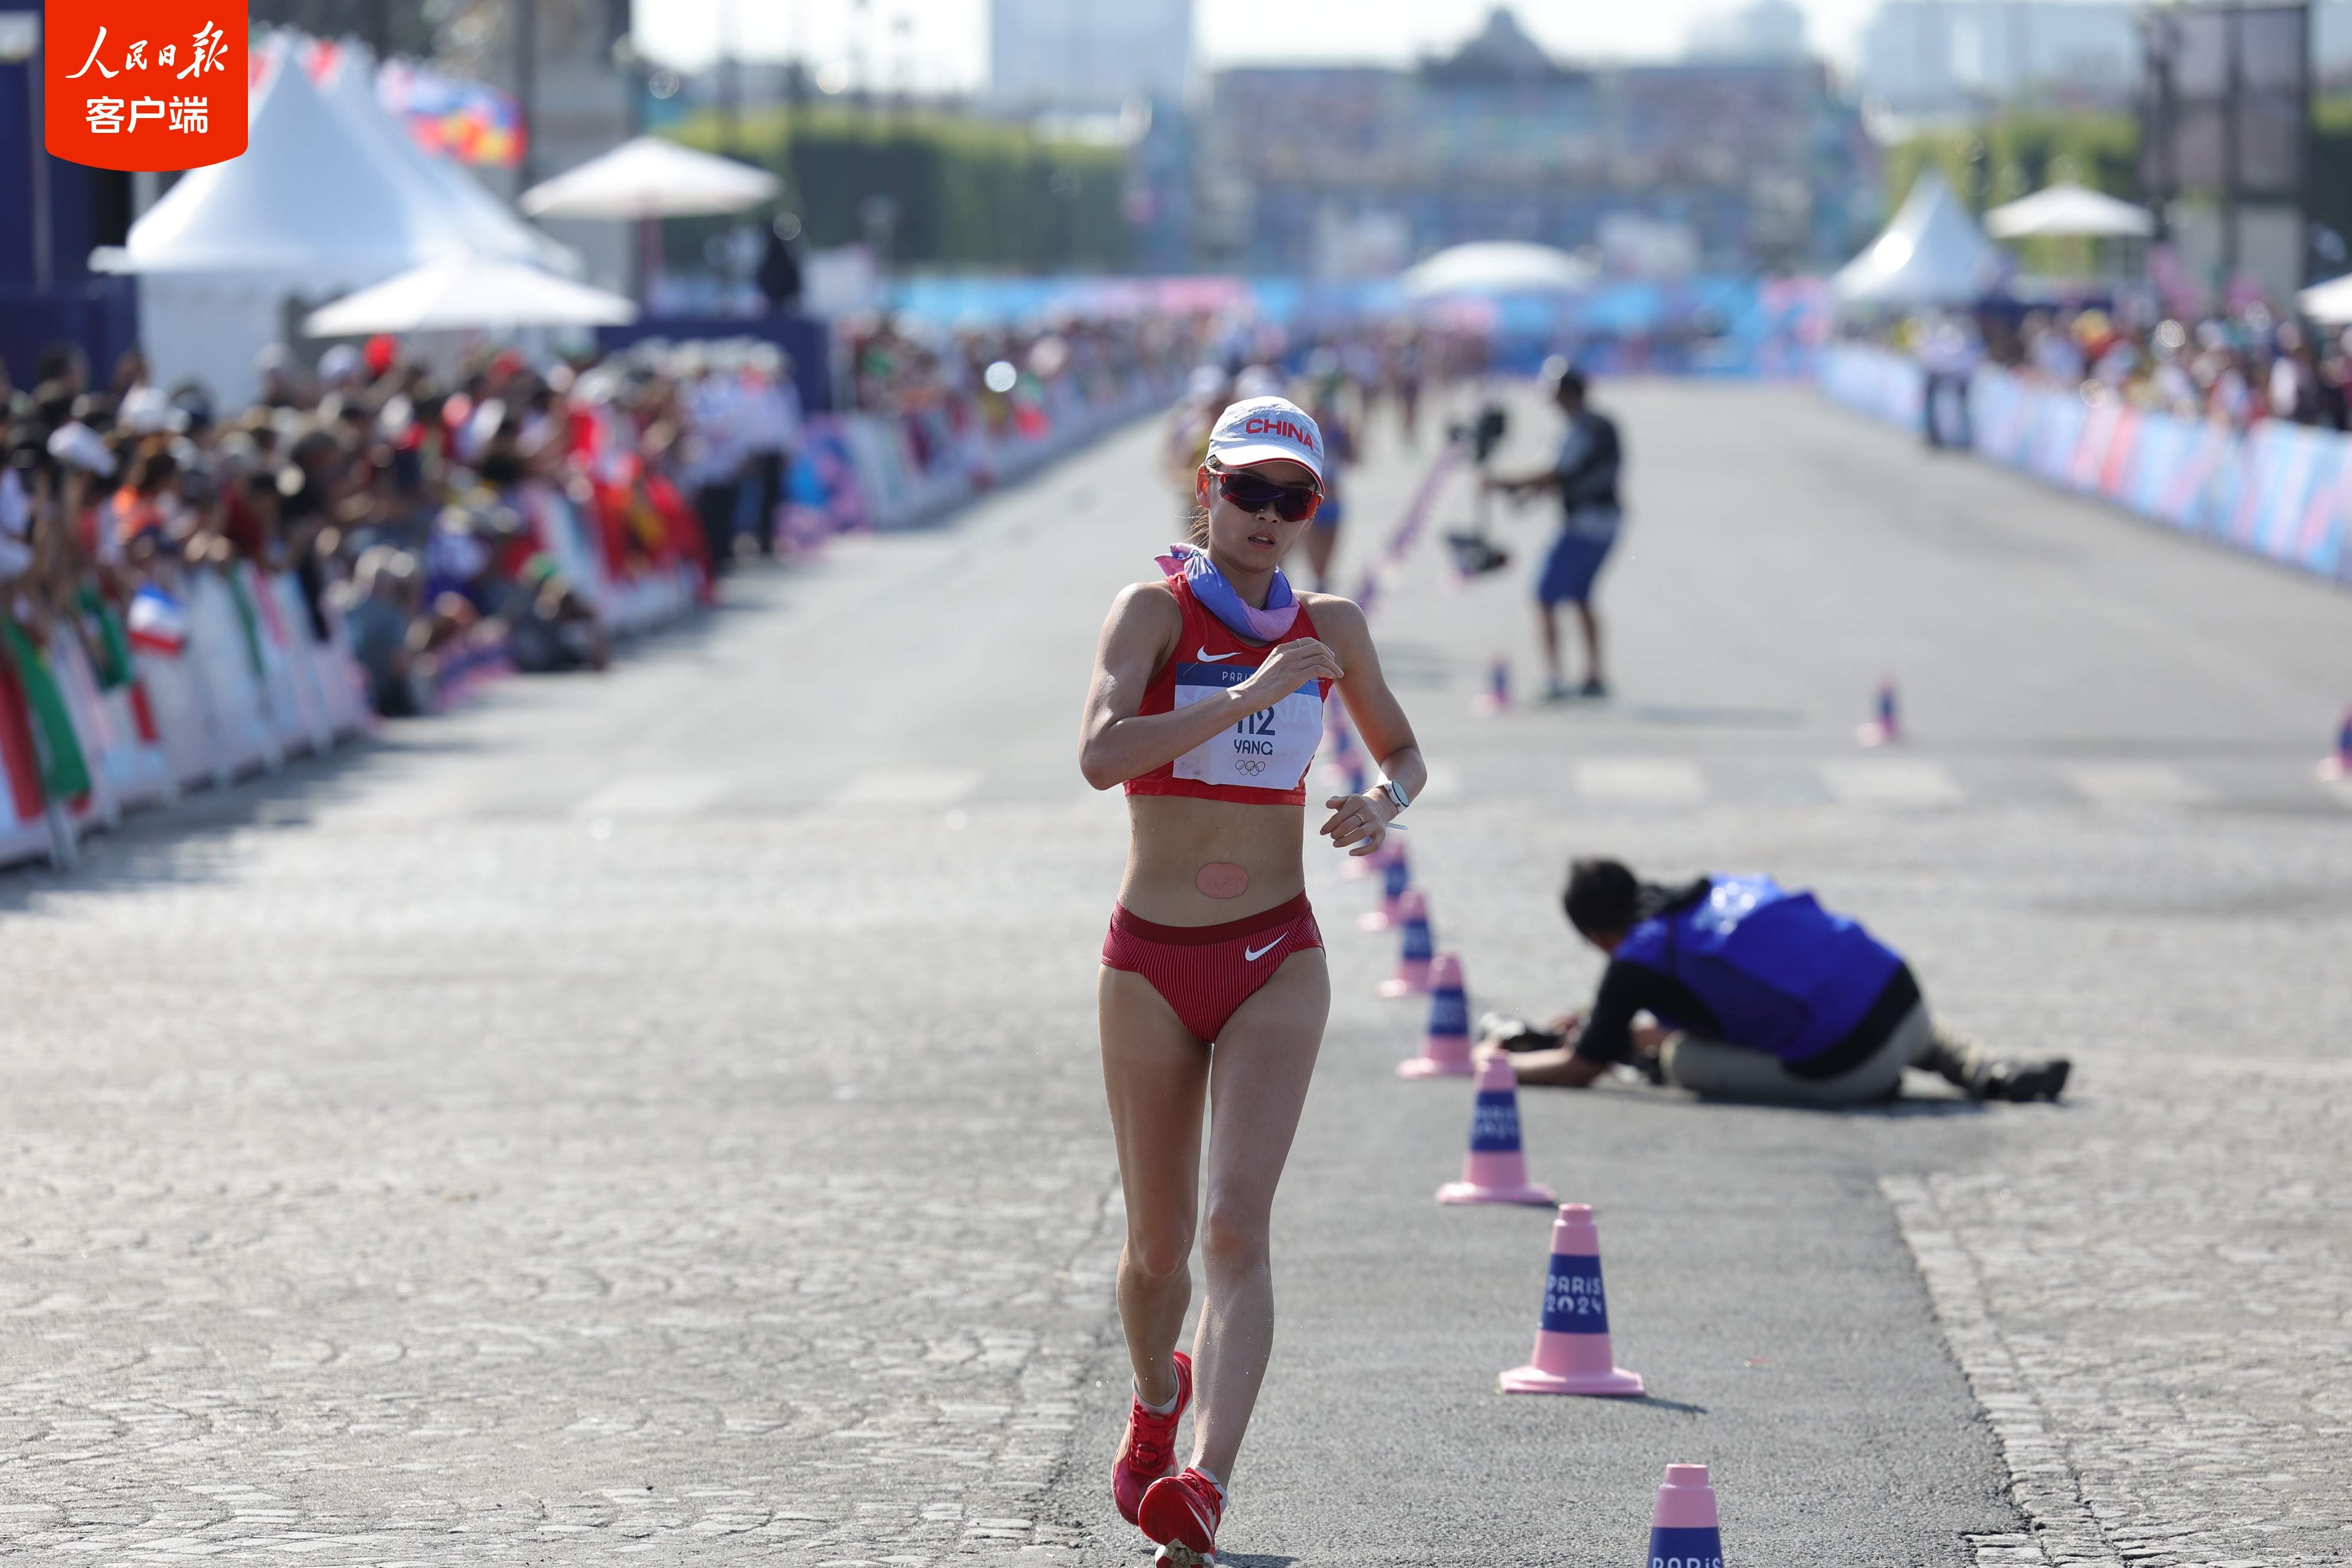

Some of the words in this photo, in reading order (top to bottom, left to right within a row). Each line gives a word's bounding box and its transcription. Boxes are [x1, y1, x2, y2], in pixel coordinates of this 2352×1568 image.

[1246, 419, 1314, 451] CHINA
[1234, 739, 1273, 755] YANG
[1546, 1293, 1602, 1315] 2024
